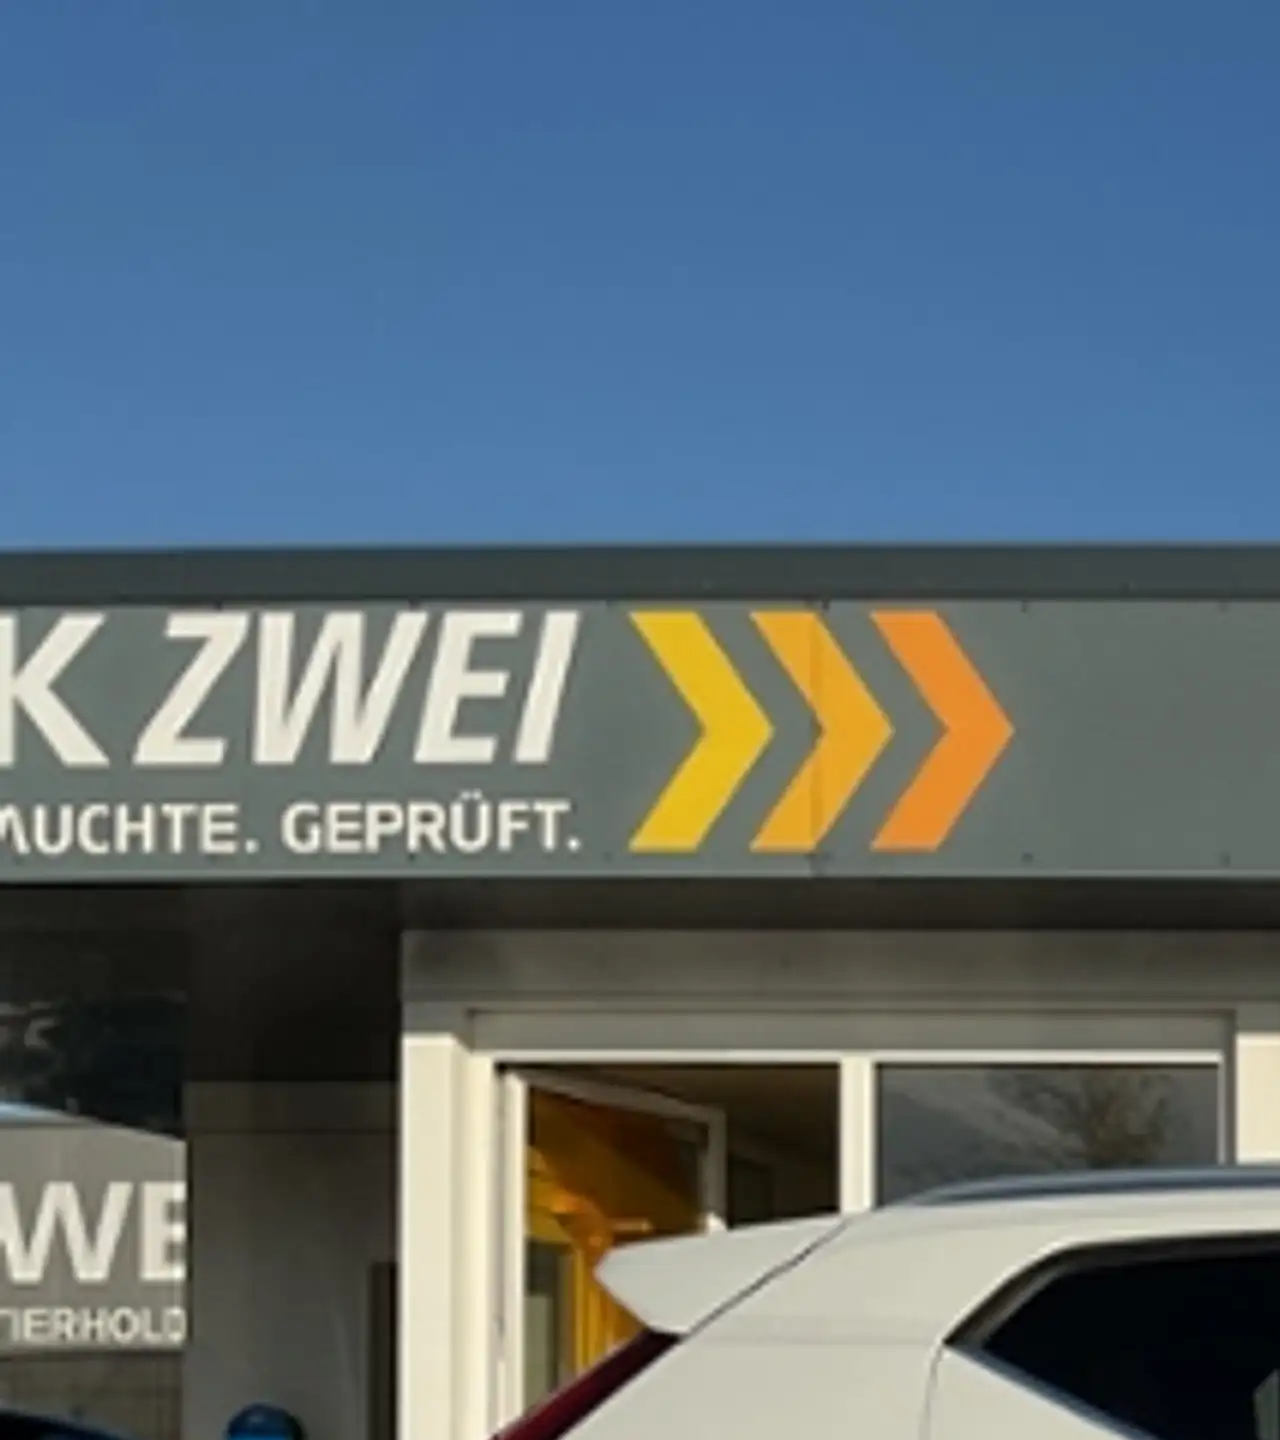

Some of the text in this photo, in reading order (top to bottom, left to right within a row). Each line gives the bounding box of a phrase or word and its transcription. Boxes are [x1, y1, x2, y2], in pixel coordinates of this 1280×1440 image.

[0, 611, 580, 768] K ZWEI
[281, 790, 581, 854] GEPRÜFT.
